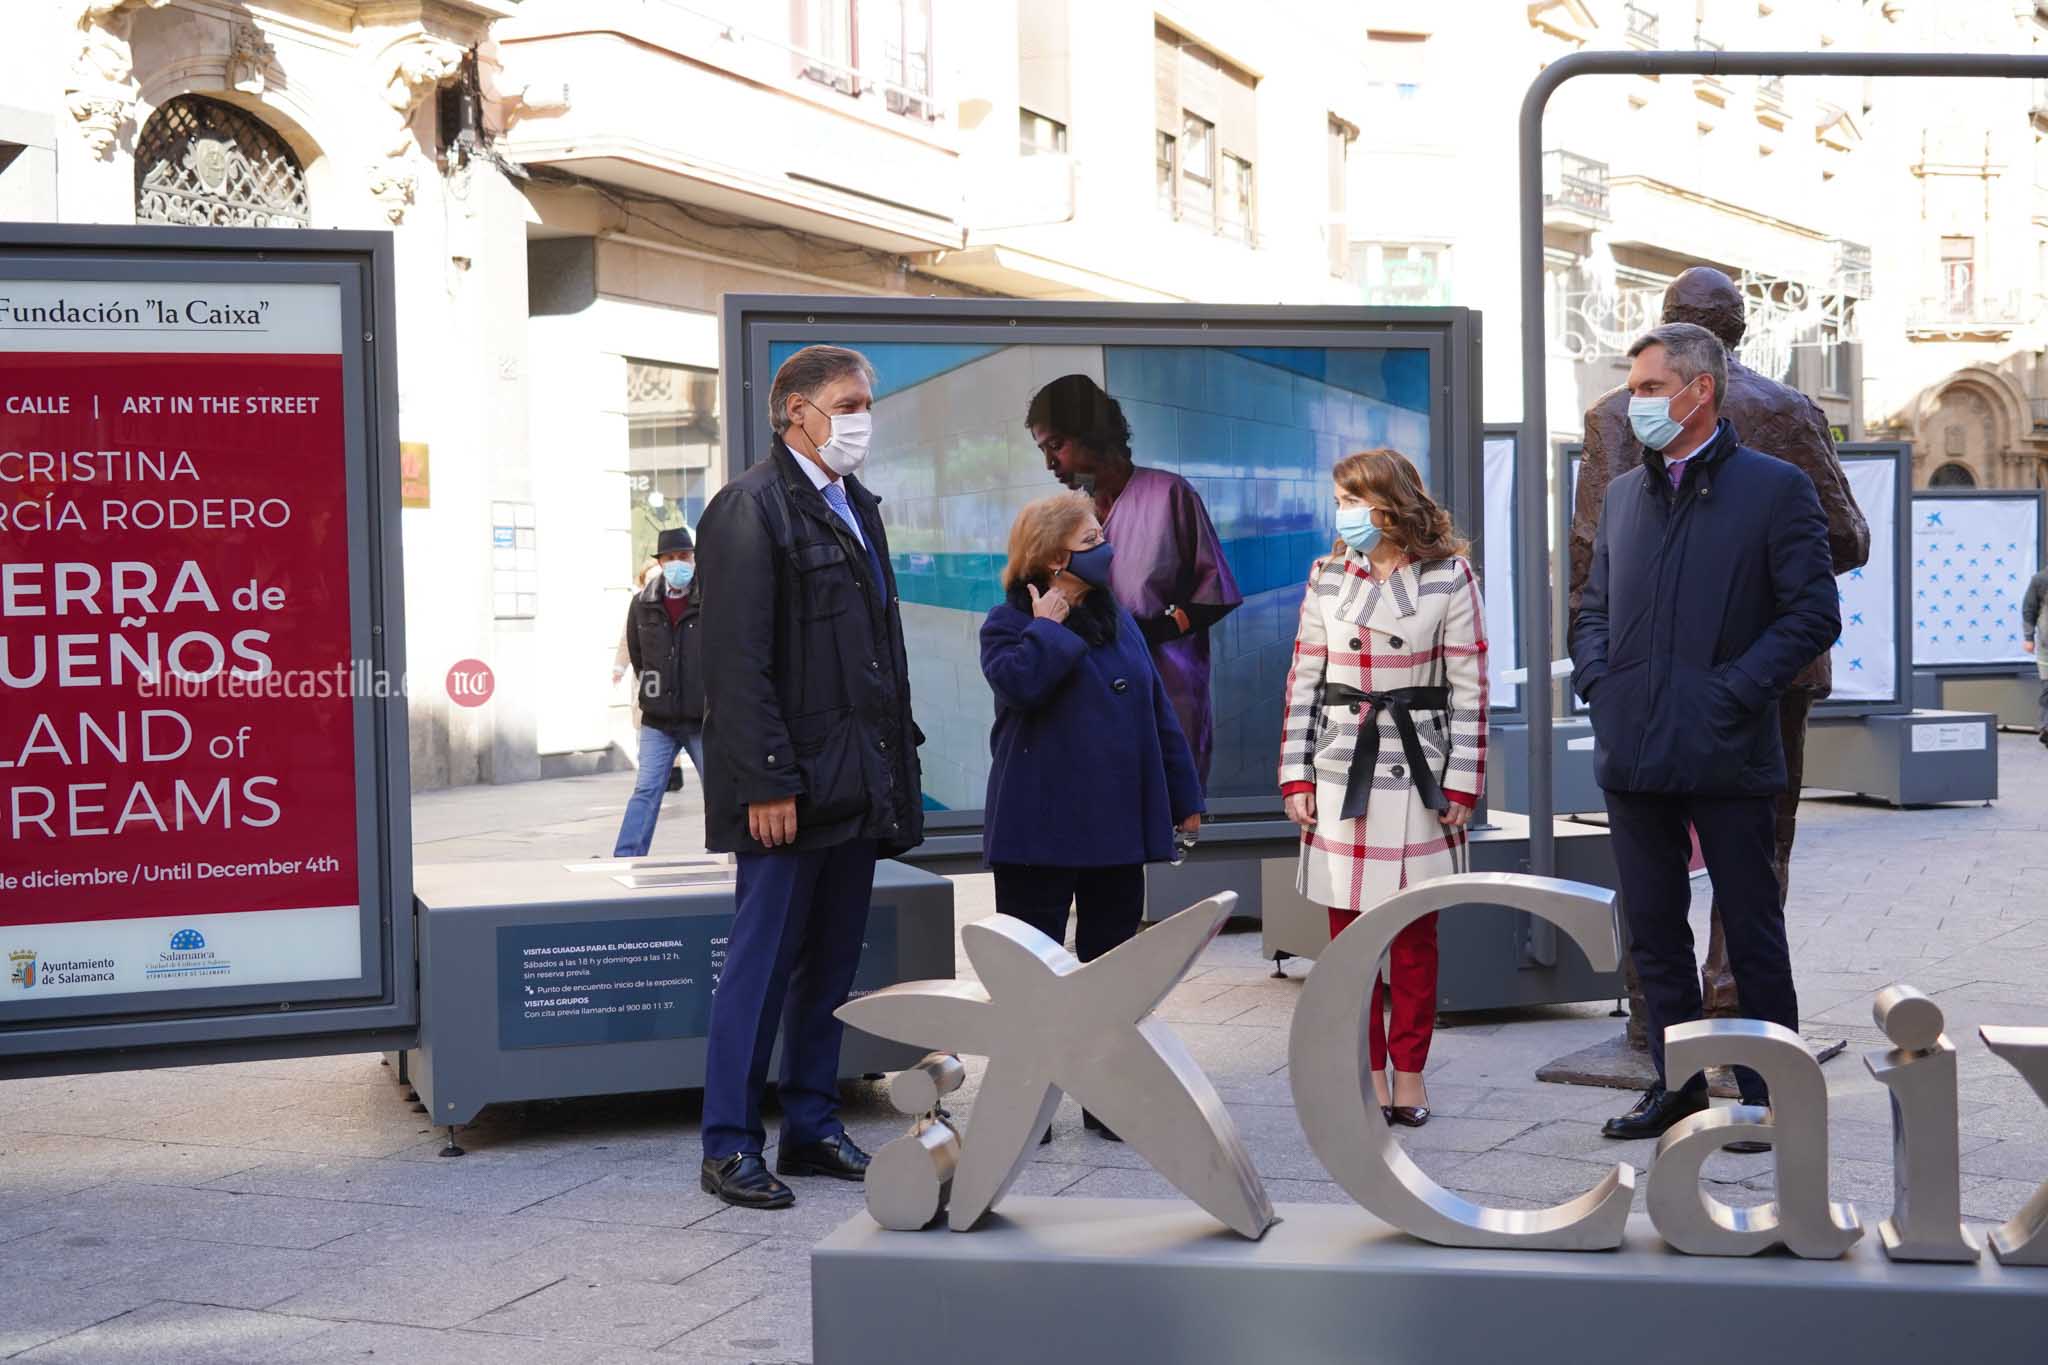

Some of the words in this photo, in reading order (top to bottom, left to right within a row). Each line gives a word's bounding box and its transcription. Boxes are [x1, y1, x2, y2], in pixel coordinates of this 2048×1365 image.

[6, 396, 70, 414] CALLE
[122, 396, 164, 414] ART
[171, 397, 193, 414] IN
[199, 397, 240, 414] THE
[246, 397, 320, 414] STREET
[0, 451, 200, 482] CRISTINA
[103, 498, 291, 530] RODERO
[2, 560, 220, 617] ERRA
[231, 579, 287, 611] de
[0, 615, 273, 689] UEÑOS
[209, 726, 252, 760] of
[0, 775, 281, 840] REAMS
[21, 868, 129, 889] diciembre
[143, 861, 192, 882] Until
[197, 858, 302, 880] December
[305, 855, 340, 873] 4th
[160, 951, 215, 961] Salamanca
[523, 947, 551, 956] VISITAS
[552, 945, 586, 954] GUIADAS
[586, 944, 607, 952] PARA
[608, 943, 617, 951] EL
[618, 940, 648, 950] PÚBLICO
[649, 939, 683, 949] GENERAL
[42, 959, 115, 973] Ayuntamiento
[523, 959, 557, 969] Sábados
[565, 958, 576, 967] las
[602, 954, 642, 965] domingos
[649, 953, 661, 962] las
[42, 973, 54, 985] de
[58, 971, 115, 984] Salamanca
[523, 971, 535, 980] sin
[537, 970, 565, 979] reserva
[537, 985, 560, 994] Punto
[561, 985, 572, 993] de
[614, 981, 634, 990] inicio
[634, 980, 645, 988] de
[646, 979, 653, 987] la
[524, 999, 555, 1008] VISITAS
[556, 997, 589, 1006] GRUPOS
[524, 1010, 541, 1018] Con
[542, 1008, 556, 1017] cita
[557, 1007, 580, 1018] previa
[581, 1005, 617, 1015] llamando
[618, 1004, 625, 1012] al
[626, 1003, 641, 1012] 900
